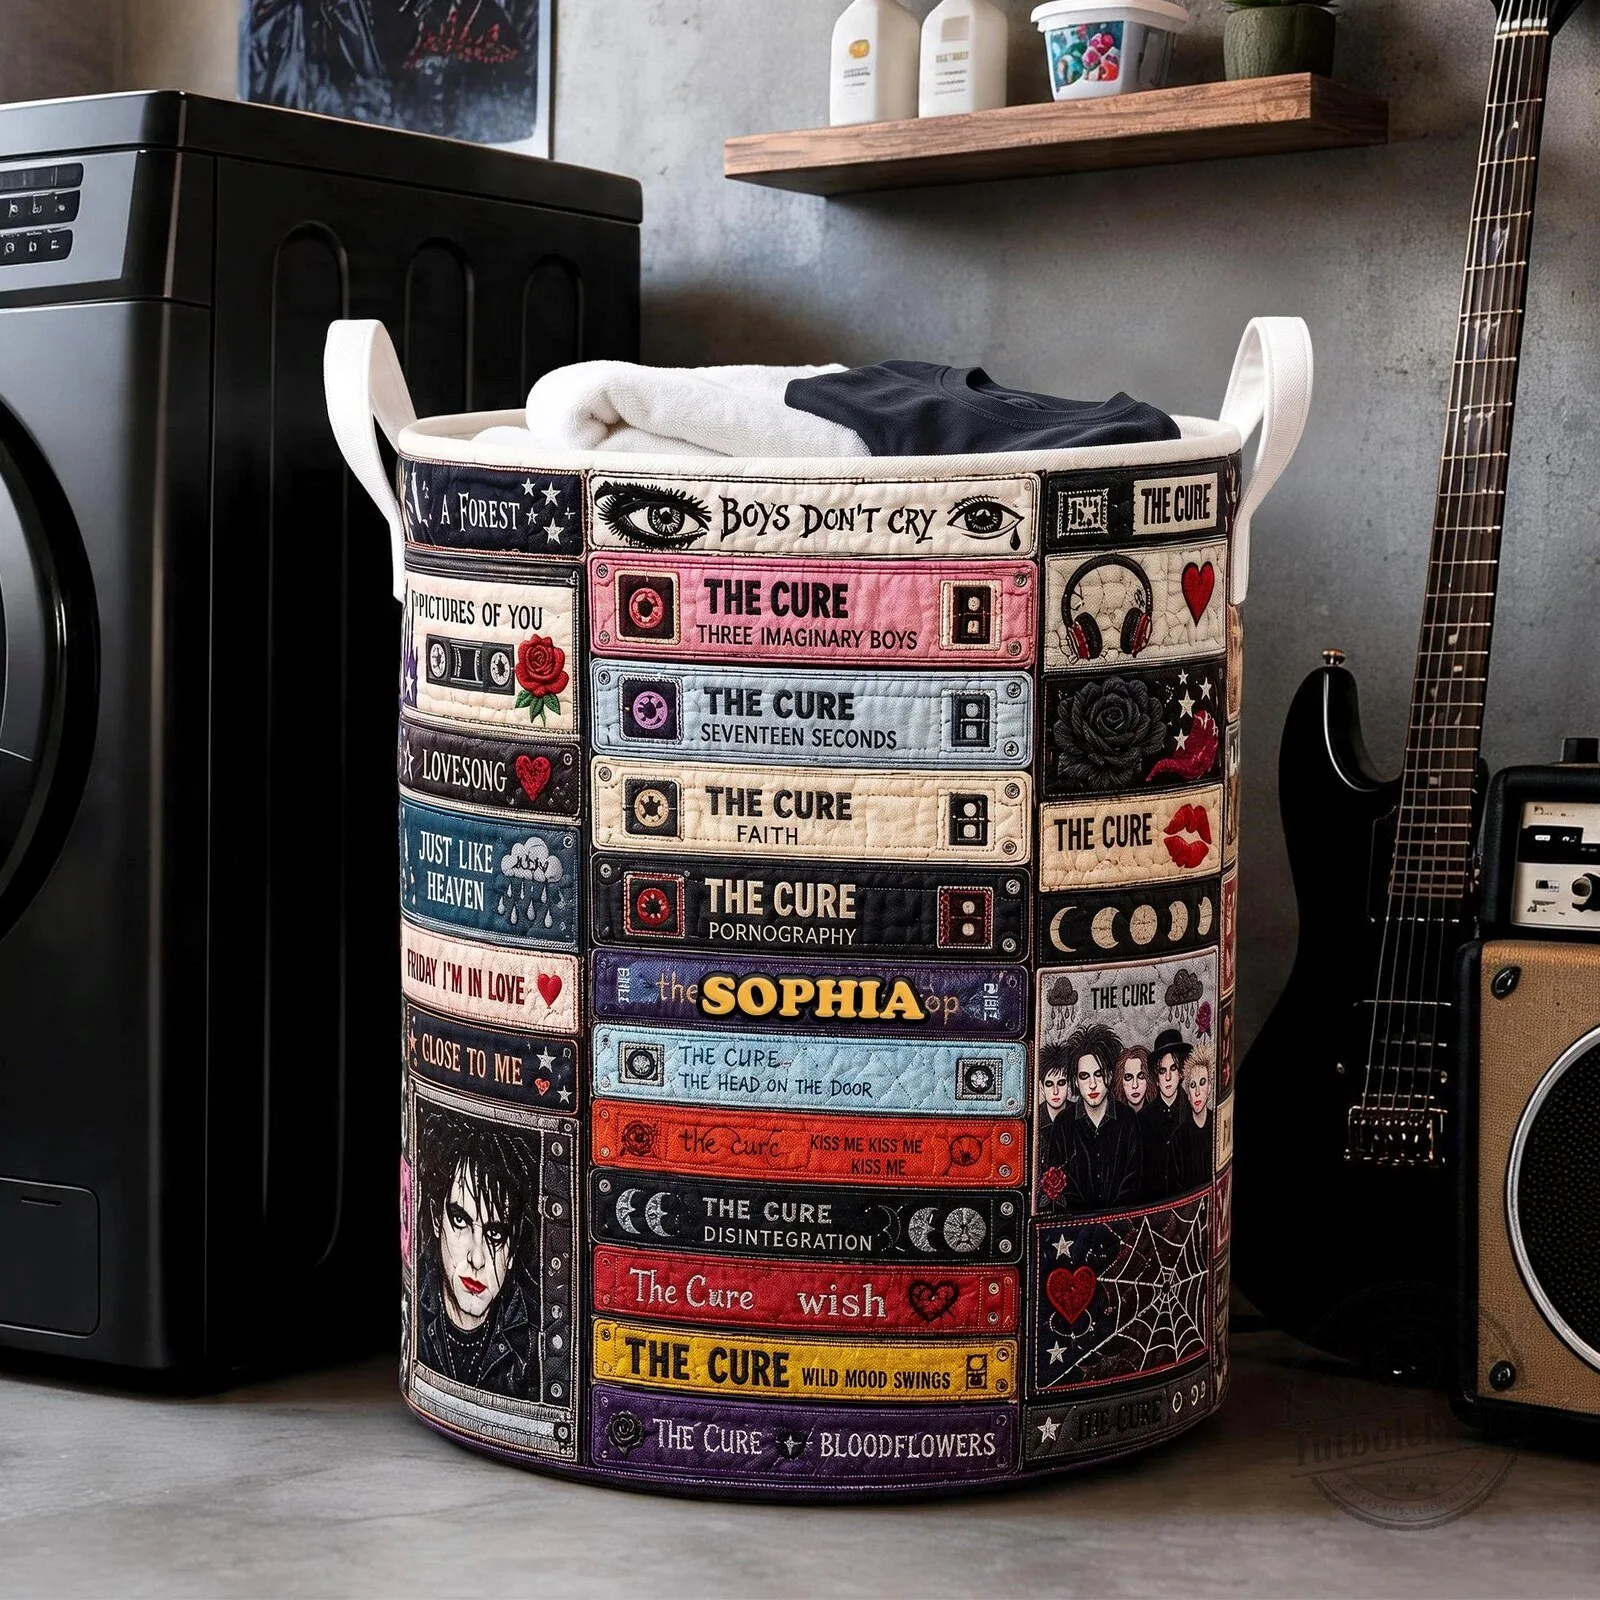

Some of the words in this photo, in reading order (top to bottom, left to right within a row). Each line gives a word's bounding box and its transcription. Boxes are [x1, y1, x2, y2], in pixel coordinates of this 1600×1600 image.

[441, 494, 450, 525] A
[458, 491, 520, 532] FOREST
[719, 495, 791, 542] BOYS
[799, 502, 881, 539] DON'T
[887, 505, 938, 544] CRY
[1140, 487, 1171, 525] THE
[1174, 483, 1212, 522] CURE
[419, 592, 475, 625] PICTURES
[482, 601, 502, 627] OF
[508, 604, 543, 630] YOU
[703, 578, 761, 616] THE
[770, 580, 849, 619] CURE
[696, 624, 753, 645] THREE
[760, 627, 864, 649] IMAGINARY
[870, 630, 918, 650] BOYS
[703, 686, 763, 717] THE
[772, 688, 855, 720] CURE
[701, 722, 804, 746] SEVENTEEN
[812, 727, 897, 750] SECONDS
[422, 749, 507, 792] LOVESONG
[705, 785, 763, 817] THE
[773, 788, 853, 821] CURE
[737, 825, 798, 846] FAITH
[1054, 817, 1095, 851] THE
[1102, 812, 1153, 848] CURE
[418, 831, 452, 867] JUST
[459, 839, 493, 873] LIKE
[427, 871, 484, 911] HEAVEN
[704, 877, 764, 916] THE
[774, 880, 857, 919] CURE
[708, 922, 857, 946] PORNOGRAPHY
[407, 948, 438, 987] FRIDAY
[443, 961, 463, 994] I'M
[468, 964, 482, 998] IN
[488, 971, 525, 1005] LOVE
[700, 975, 926, 1021] SOPHIA
[1091, 985, 1118, 1010] THE
[1122, 982, 1156, 1005] CURE
[422, 1033, 461, 1072] CLOSE
[466, 1046, 486, 1078] TO
[494, 1053, 523, 1086] ME
[679, 1046, 715, 1065] THE
[724, 1048, 780, 1068] CURE
[678, 1072, 710, 1090] THE
[718, 1074, 760, 1092] HEAD
[767, 1079, 788, 1092] ON
[795, 1079, 822, 1095] THE
[830, 1080, 872, 1098] DOOR
[679, 1127, 719, 1155] the
[810, 1134, 839, 1150] KISS
[844, 1137, 863, 1151] ME
[869, 1138, 898, 1153] KISS
[903, 1139, 922, 1154] ME
[851, 1159, 881, 1174] KISS
[886, 1160, 906, 1175] ME
[703, 1197, 750, 1220] THE
[764, 1201, 832, 1224] CURE
[704, 1226, 872, 1251] DISINTEGRATION
[629, 1267, 678, 1304] The
[686, 1274, 754, 1310] Cure
[797, 1283, 887, 1318] wish
[625, 1337, 690, 1380] THE
[708, 1346, 790, 1388] CURE
[801, 1367, 839, 1387] WILD
[845, 1369, 887, 1389] MOOD
[893, 1371, 950, 1390] SWINGS
[704, 1423, 763, 1456] CURE
[820, 1432, 997, 1459] BLOODFLOWERS
